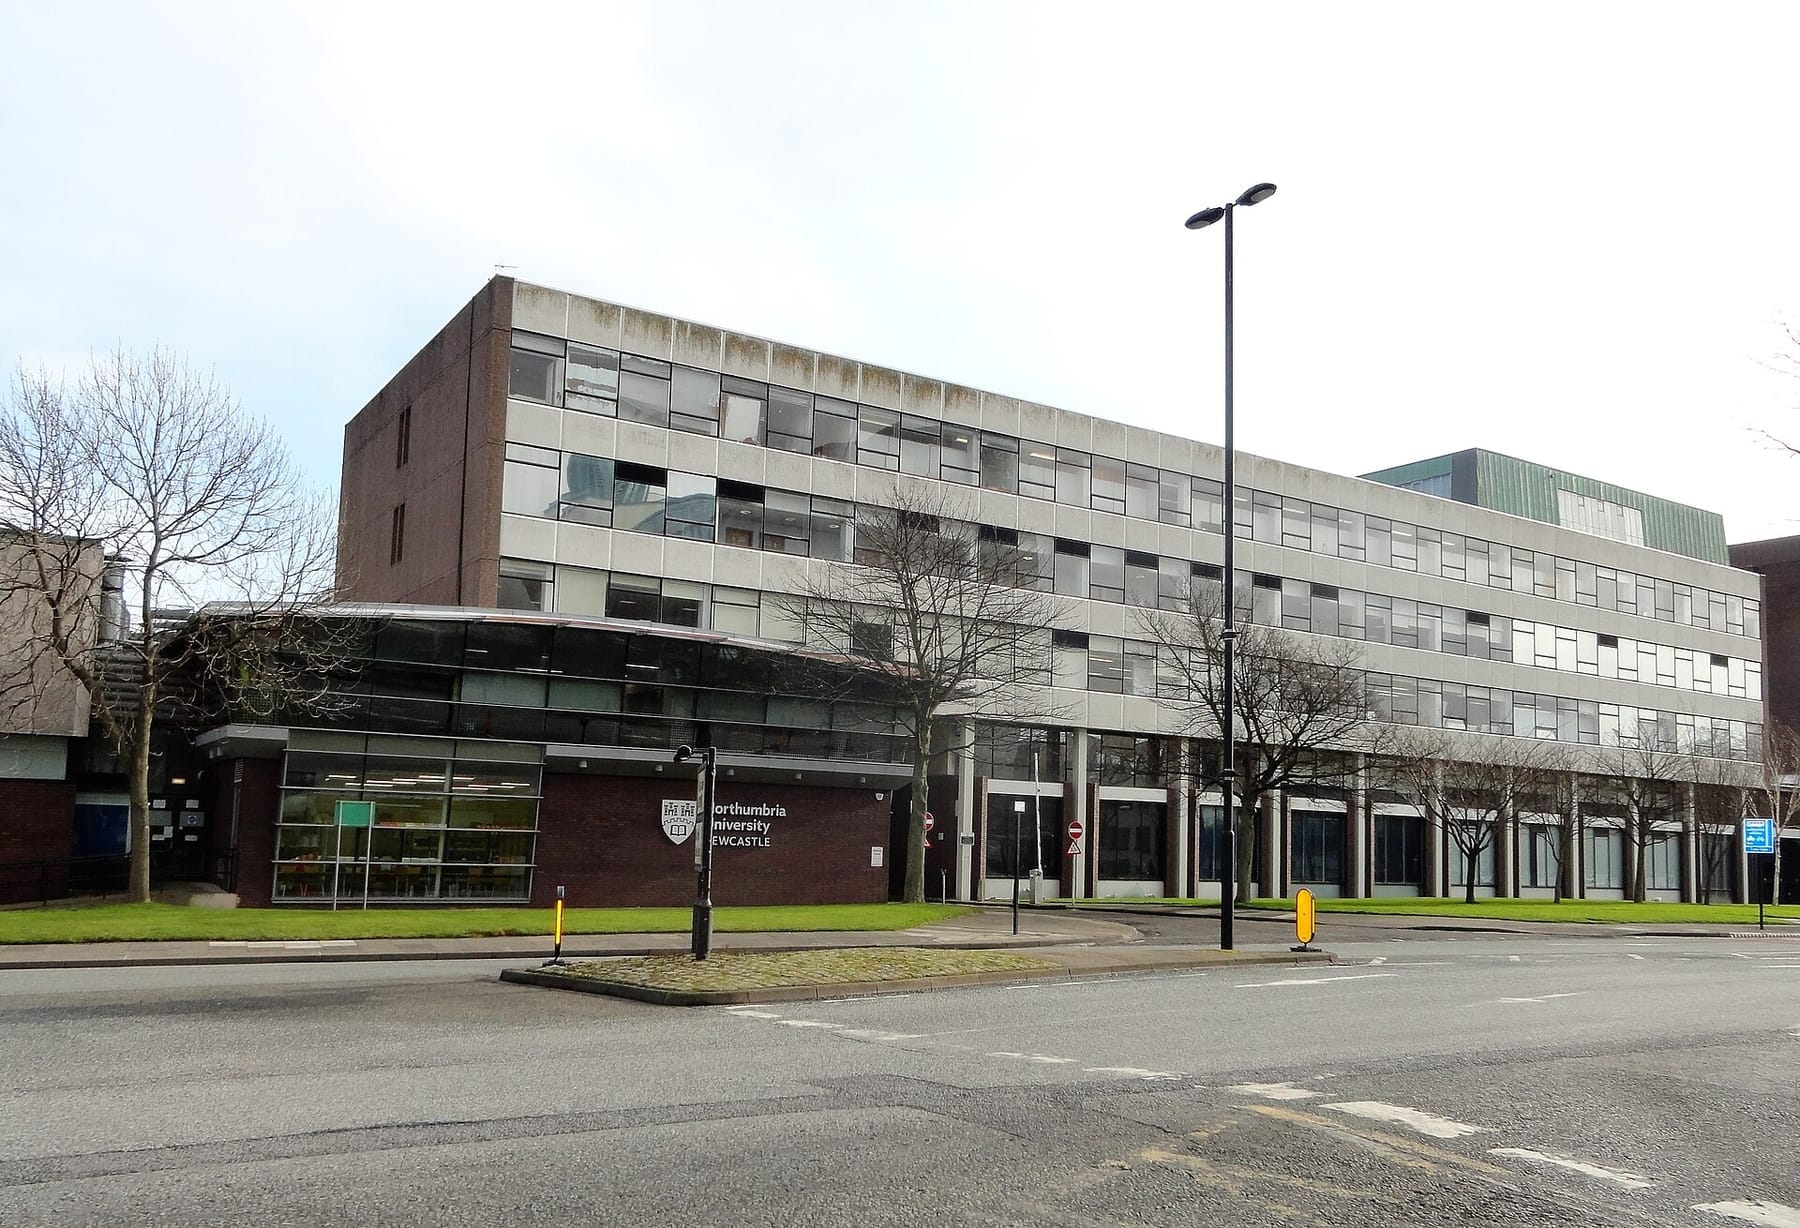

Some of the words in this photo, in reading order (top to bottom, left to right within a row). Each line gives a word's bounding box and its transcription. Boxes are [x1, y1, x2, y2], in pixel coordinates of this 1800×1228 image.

[713, 801, 787, 817] orthumbria
[713, 817, 771, 835] niversity
[712, 835, 771, 847] EWCASTLE
